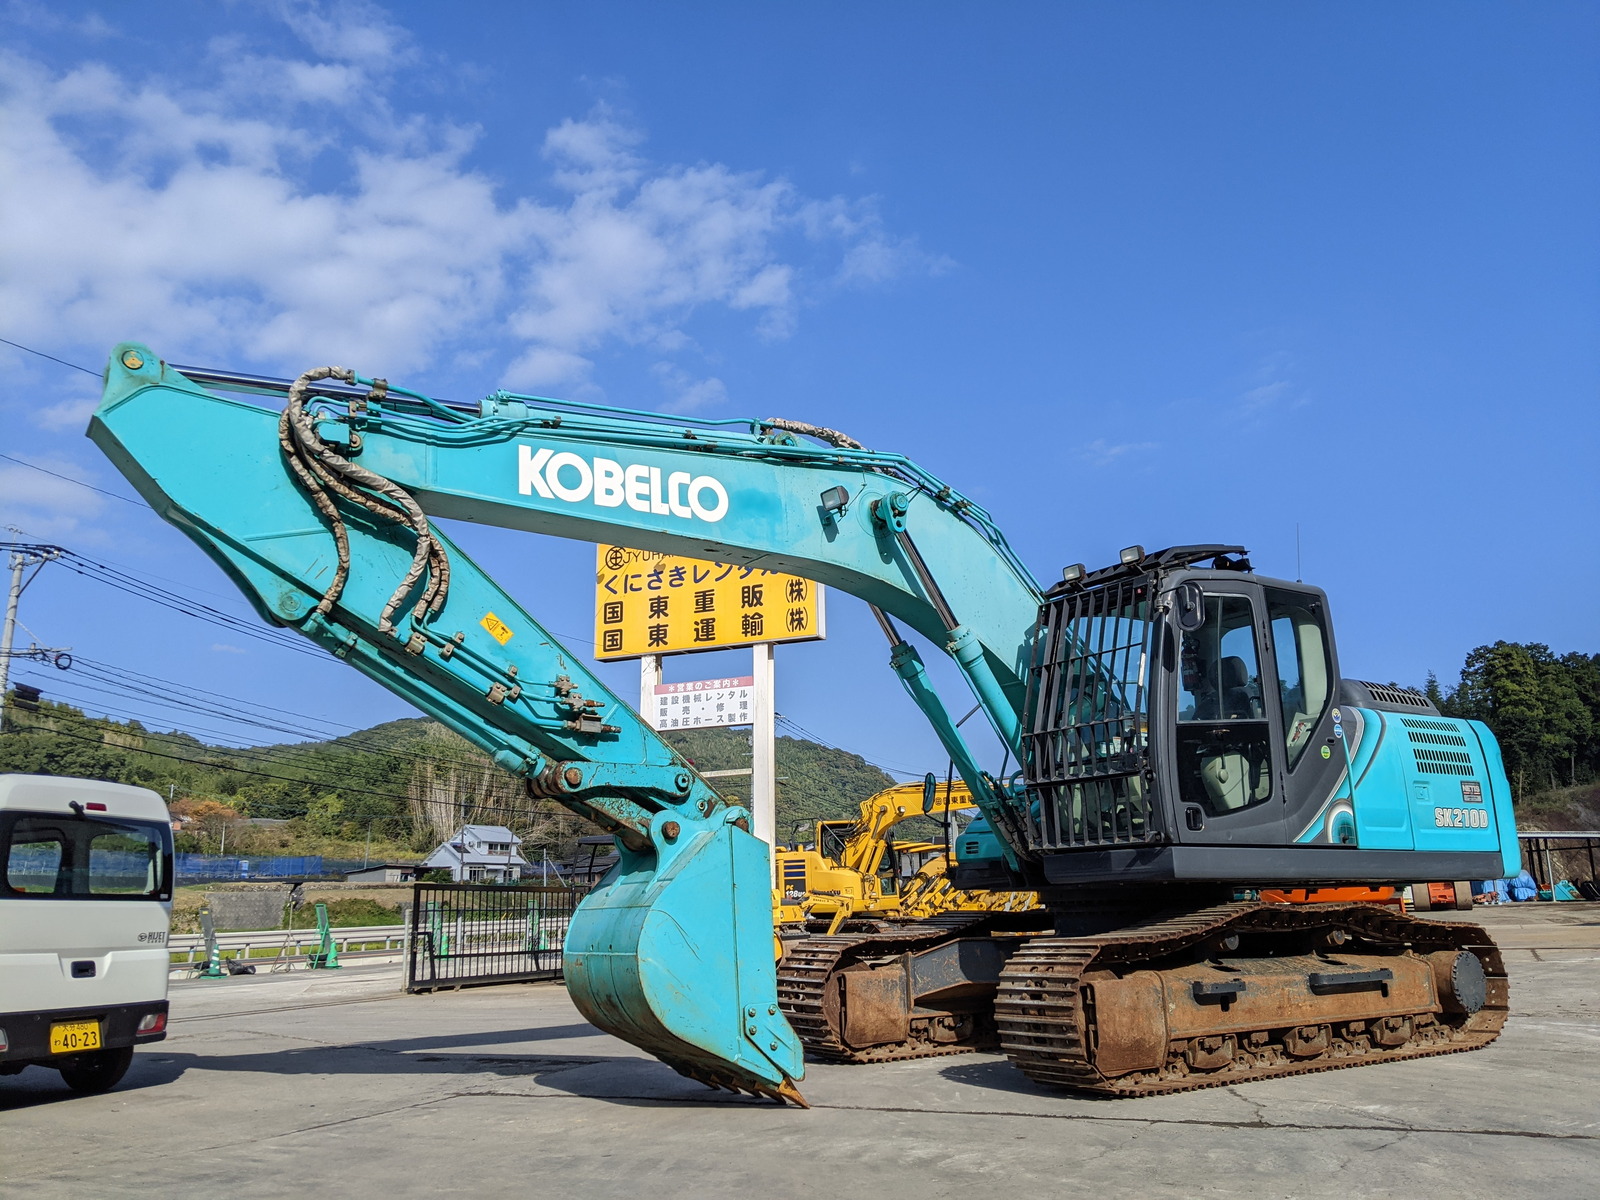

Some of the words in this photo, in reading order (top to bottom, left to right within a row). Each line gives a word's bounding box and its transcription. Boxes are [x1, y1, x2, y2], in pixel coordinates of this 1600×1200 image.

[518, 444, 729, 522] KOBELCO
[604, 562, 779, 595] くにさきレンタ
[660, 690, 748, 706] 建設機械レンタル
[1434, 807, 1488, 828] SK210D
[63, 1031, 97, 1048] 40-23
